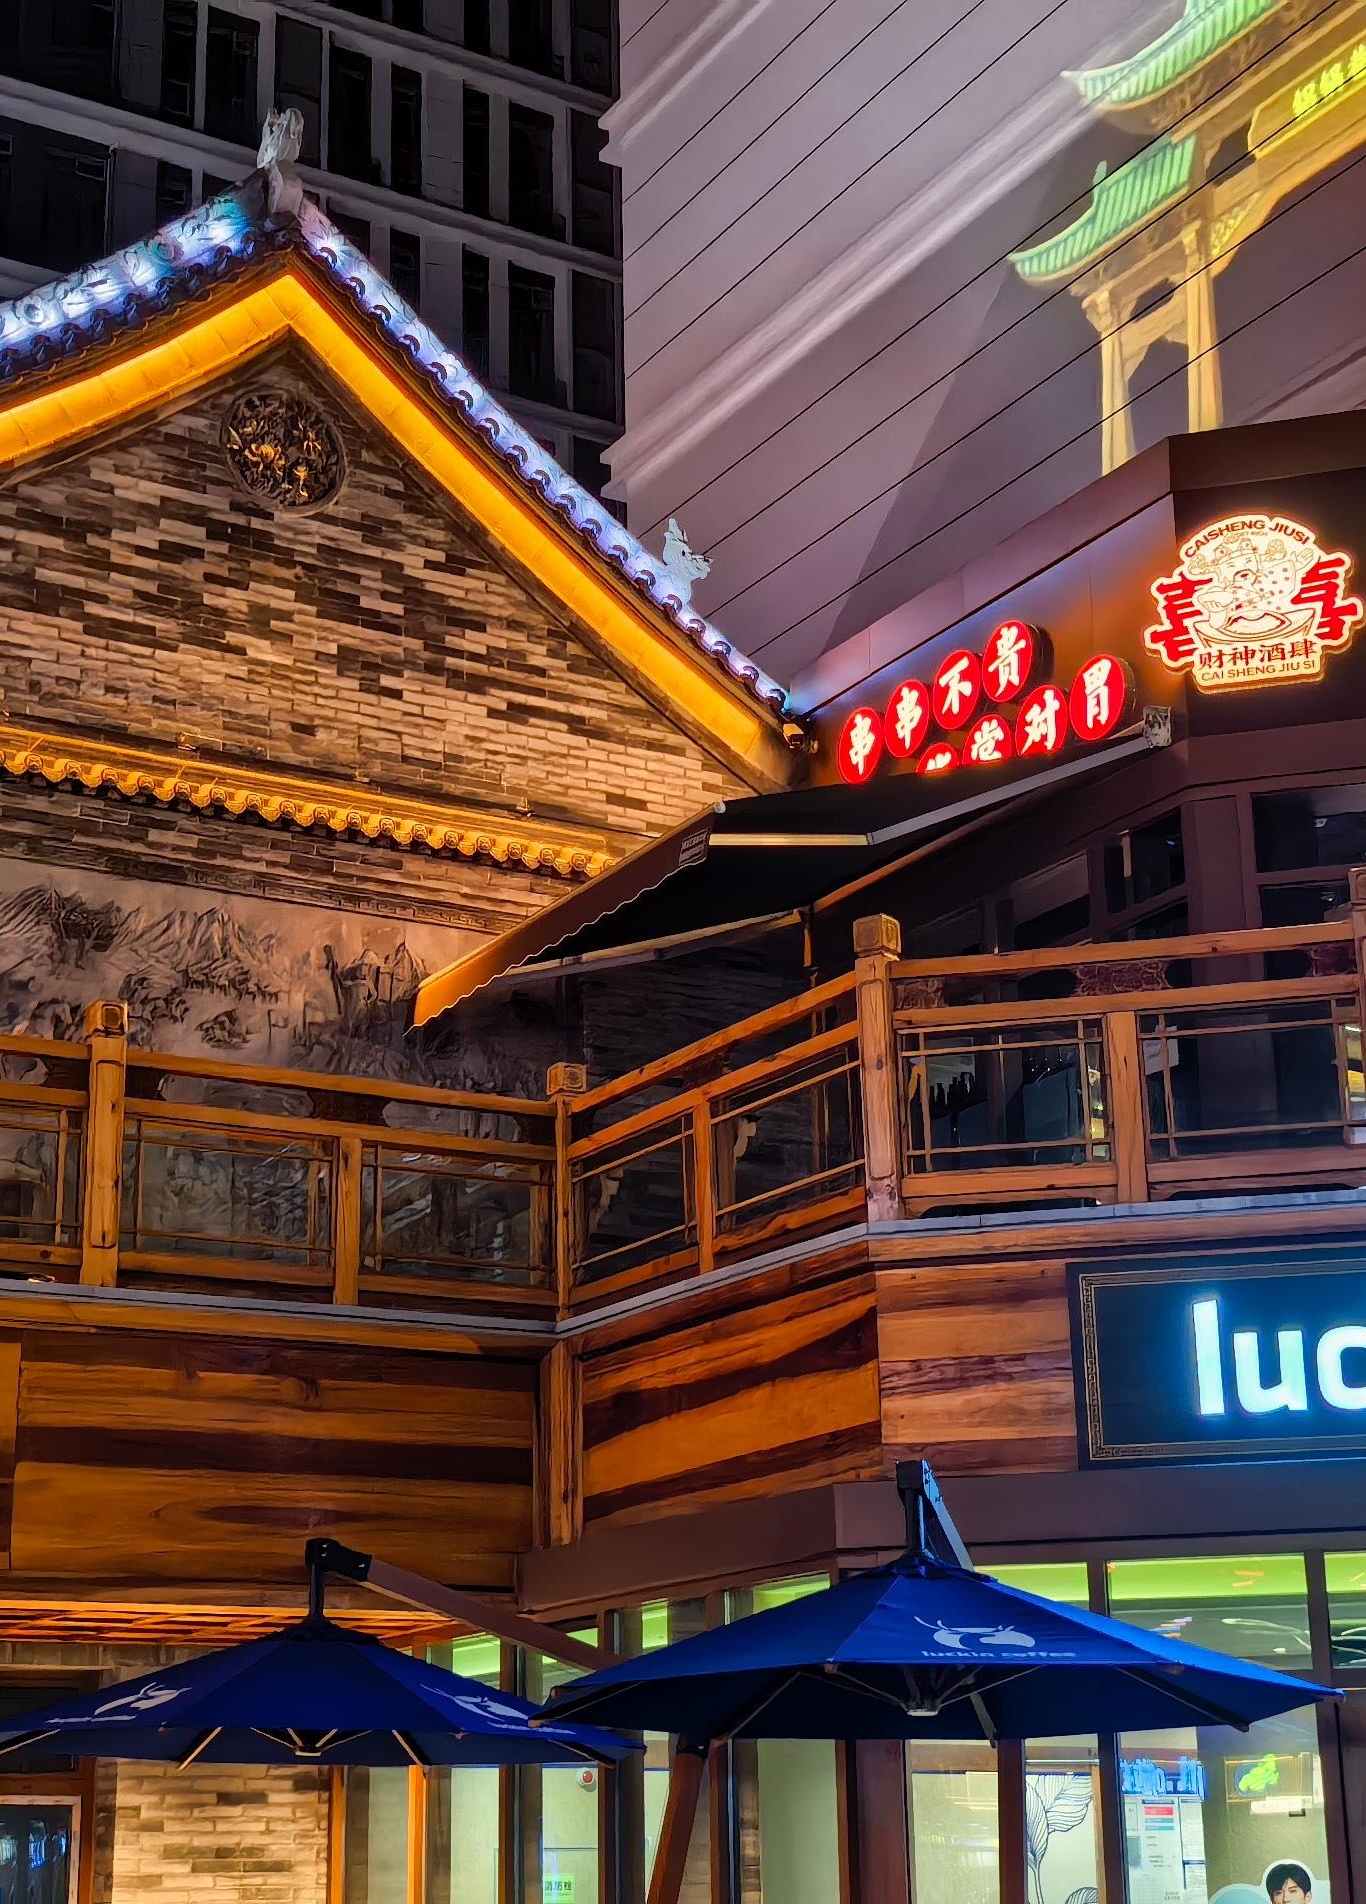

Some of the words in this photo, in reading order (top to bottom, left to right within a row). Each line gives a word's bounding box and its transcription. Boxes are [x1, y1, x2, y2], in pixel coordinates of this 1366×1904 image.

[1185, 519, 1266, 558] CAISHENG
[1269, 522, 1310, 545] JIUSI
[1197, 638, 1317, 669] 财神酒肆
[1201, 670, 1225, 681] CAI
[1227, 664, 1276, 679] SHENG
[848, 625, 1027, 776] 串串不贵
